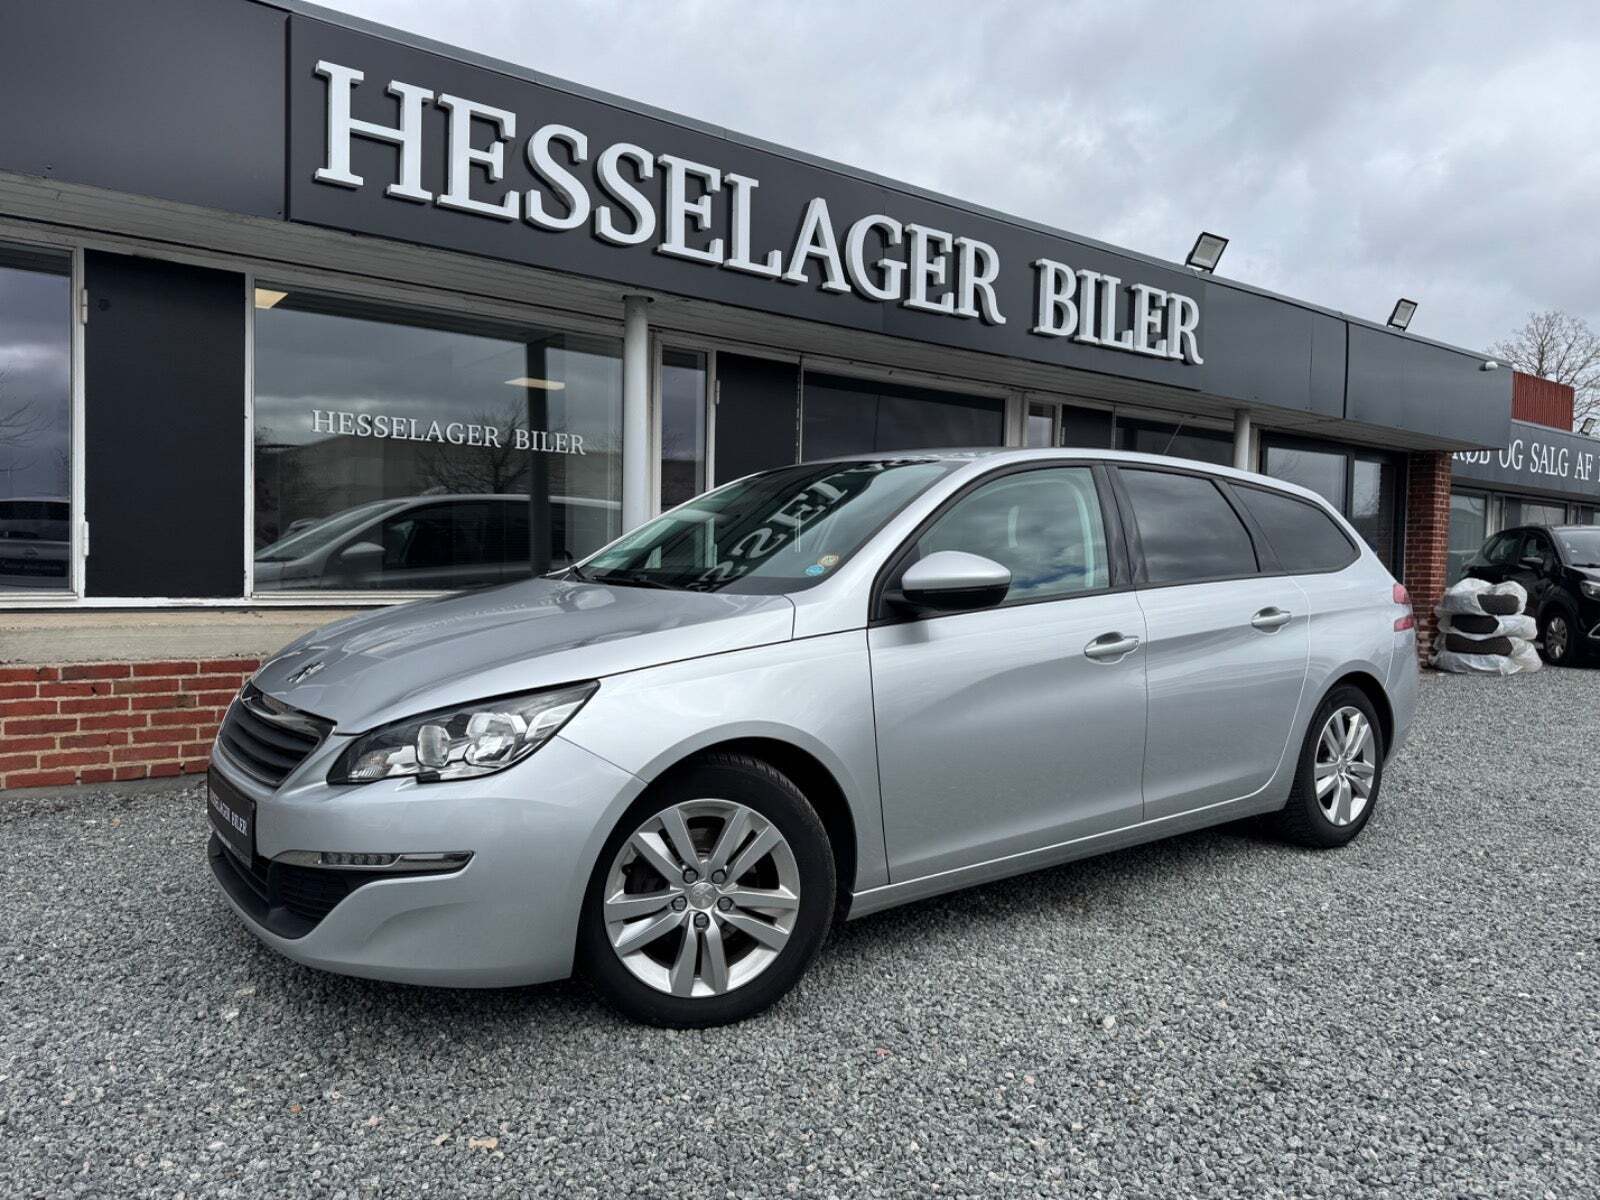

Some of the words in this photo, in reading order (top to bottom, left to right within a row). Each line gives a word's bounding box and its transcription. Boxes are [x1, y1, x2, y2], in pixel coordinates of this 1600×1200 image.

[314, 60, 1007, 326] HESSELAGER
[1031, 257, 1204, 366] BILER
[311, 408, 502, 448] HESSELAGER
[514, 428, 587, 455] BILER
[1529, 442, 1569, 477] SALG
[1573, 451, 1593, 480] AF
